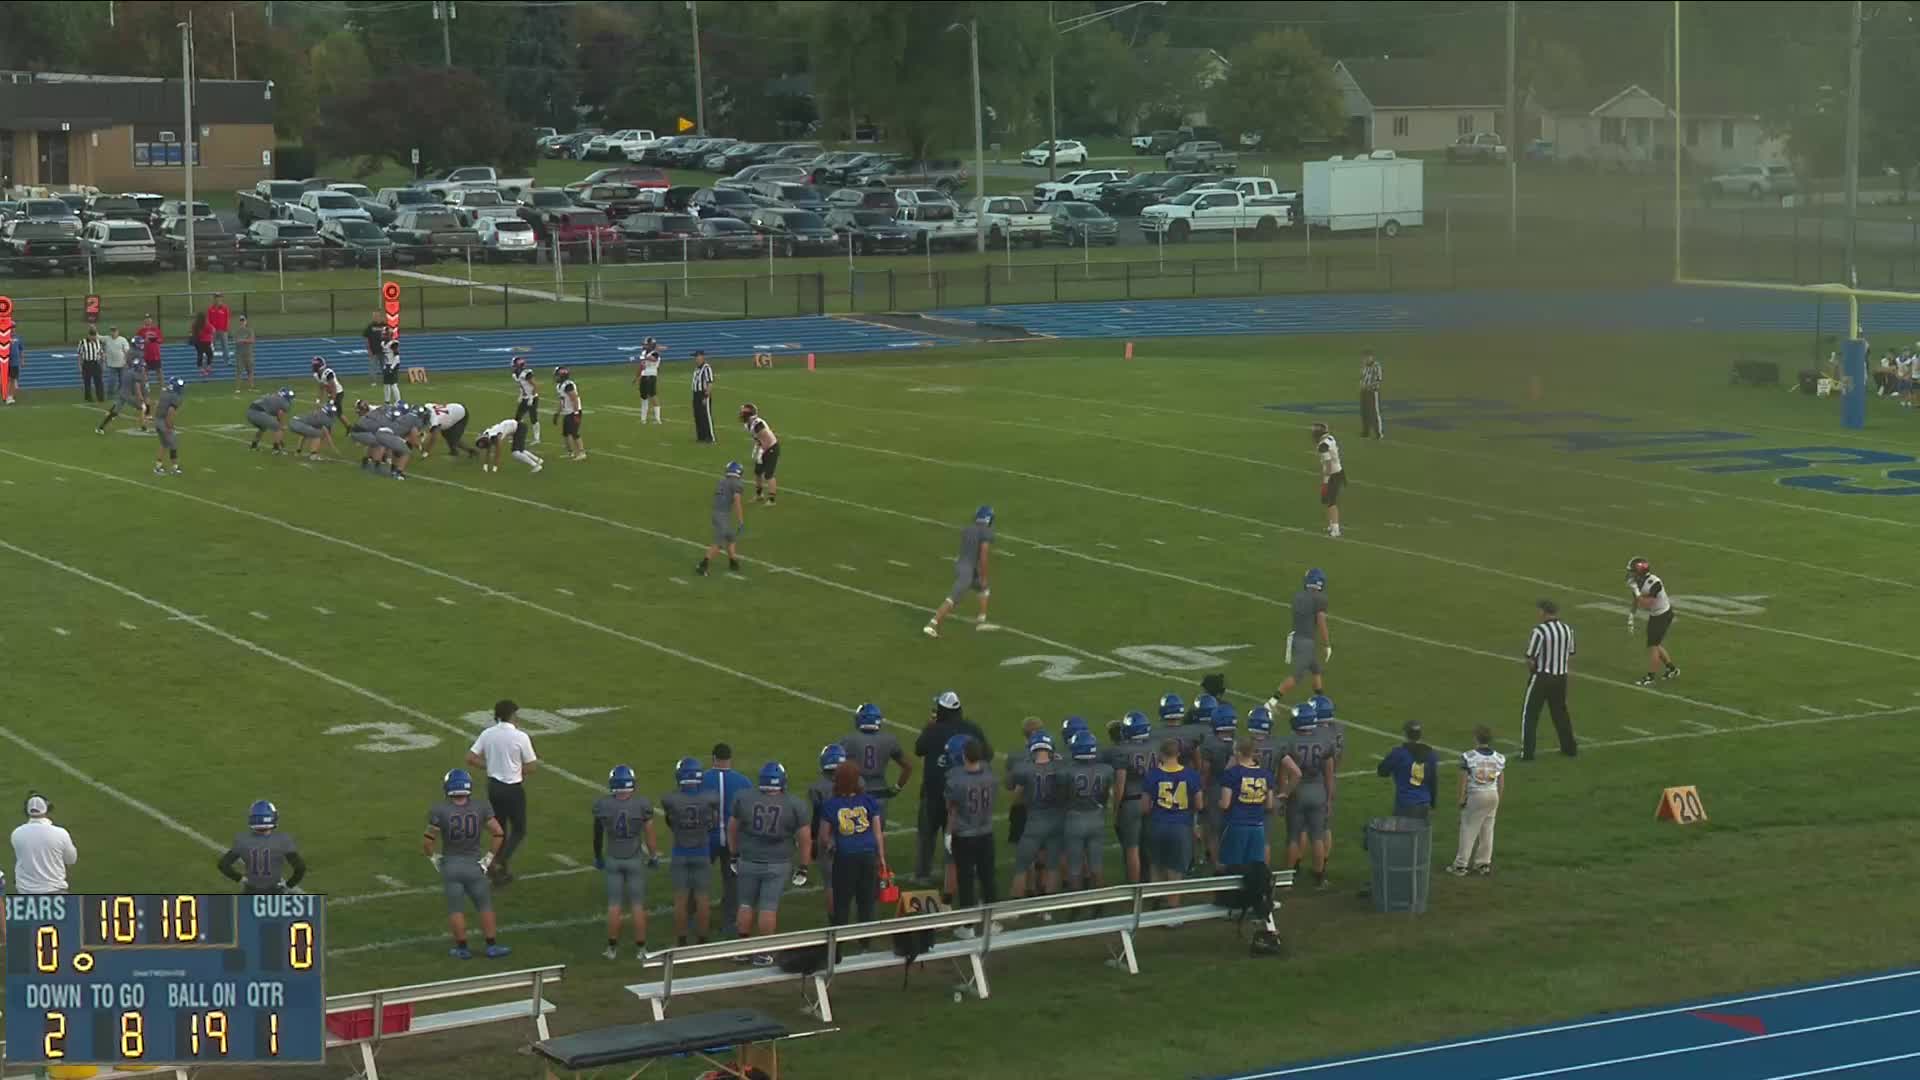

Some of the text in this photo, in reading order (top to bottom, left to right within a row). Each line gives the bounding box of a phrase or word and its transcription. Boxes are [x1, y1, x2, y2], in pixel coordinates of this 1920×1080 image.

[86, 297, 99, 313] 2
[1156, 779, 1189, 811] 54
[1672, 790, 1701, 822] 20
[449, 813, 480, 842] 20
[613, 810, 631, 838] 4
[752, 801, 783, 834] 67
[838, 806, 870, 835] 63
[249, 847, 271, 877] 11
